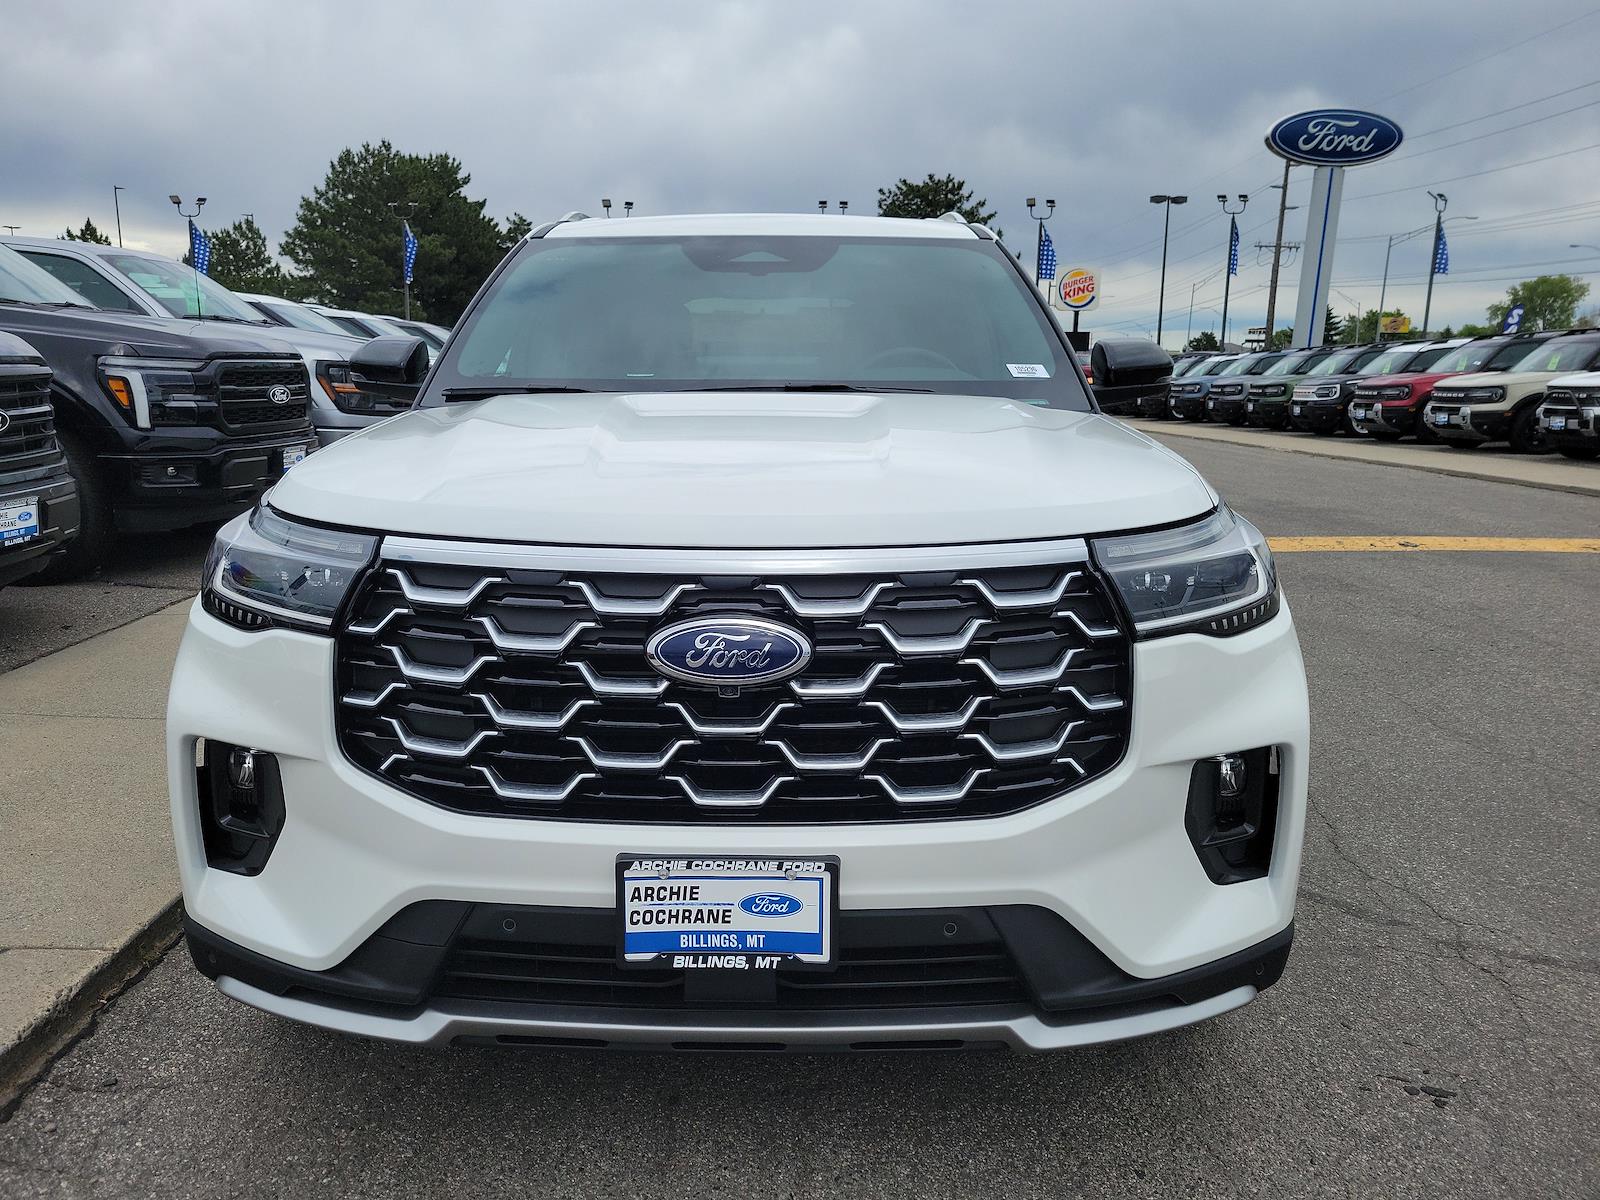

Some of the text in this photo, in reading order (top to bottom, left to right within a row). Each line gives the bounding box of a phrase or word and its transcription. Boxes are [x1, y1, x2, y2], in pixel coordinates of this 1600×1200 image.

[1298, 118, 1378, 152] Ford
[1063, 276, 1094, 290] BURGER
[1064, 283, 1094, 300] KING
[274, 388, 287, 400] Ford
[686, 632, 772, 668] Ford
[630, 860, 826, 873] ARCHIE COCHRANE FORD
[630, 886, 700, 902] ARCHIE
[751, 895, 789, 913] Ford
[629, 909, 732, 926] COCHRANE
[680, 934, 765, 949] BILLINGS, MT
[672, 955, 781, 970] BILLINGS, MT
